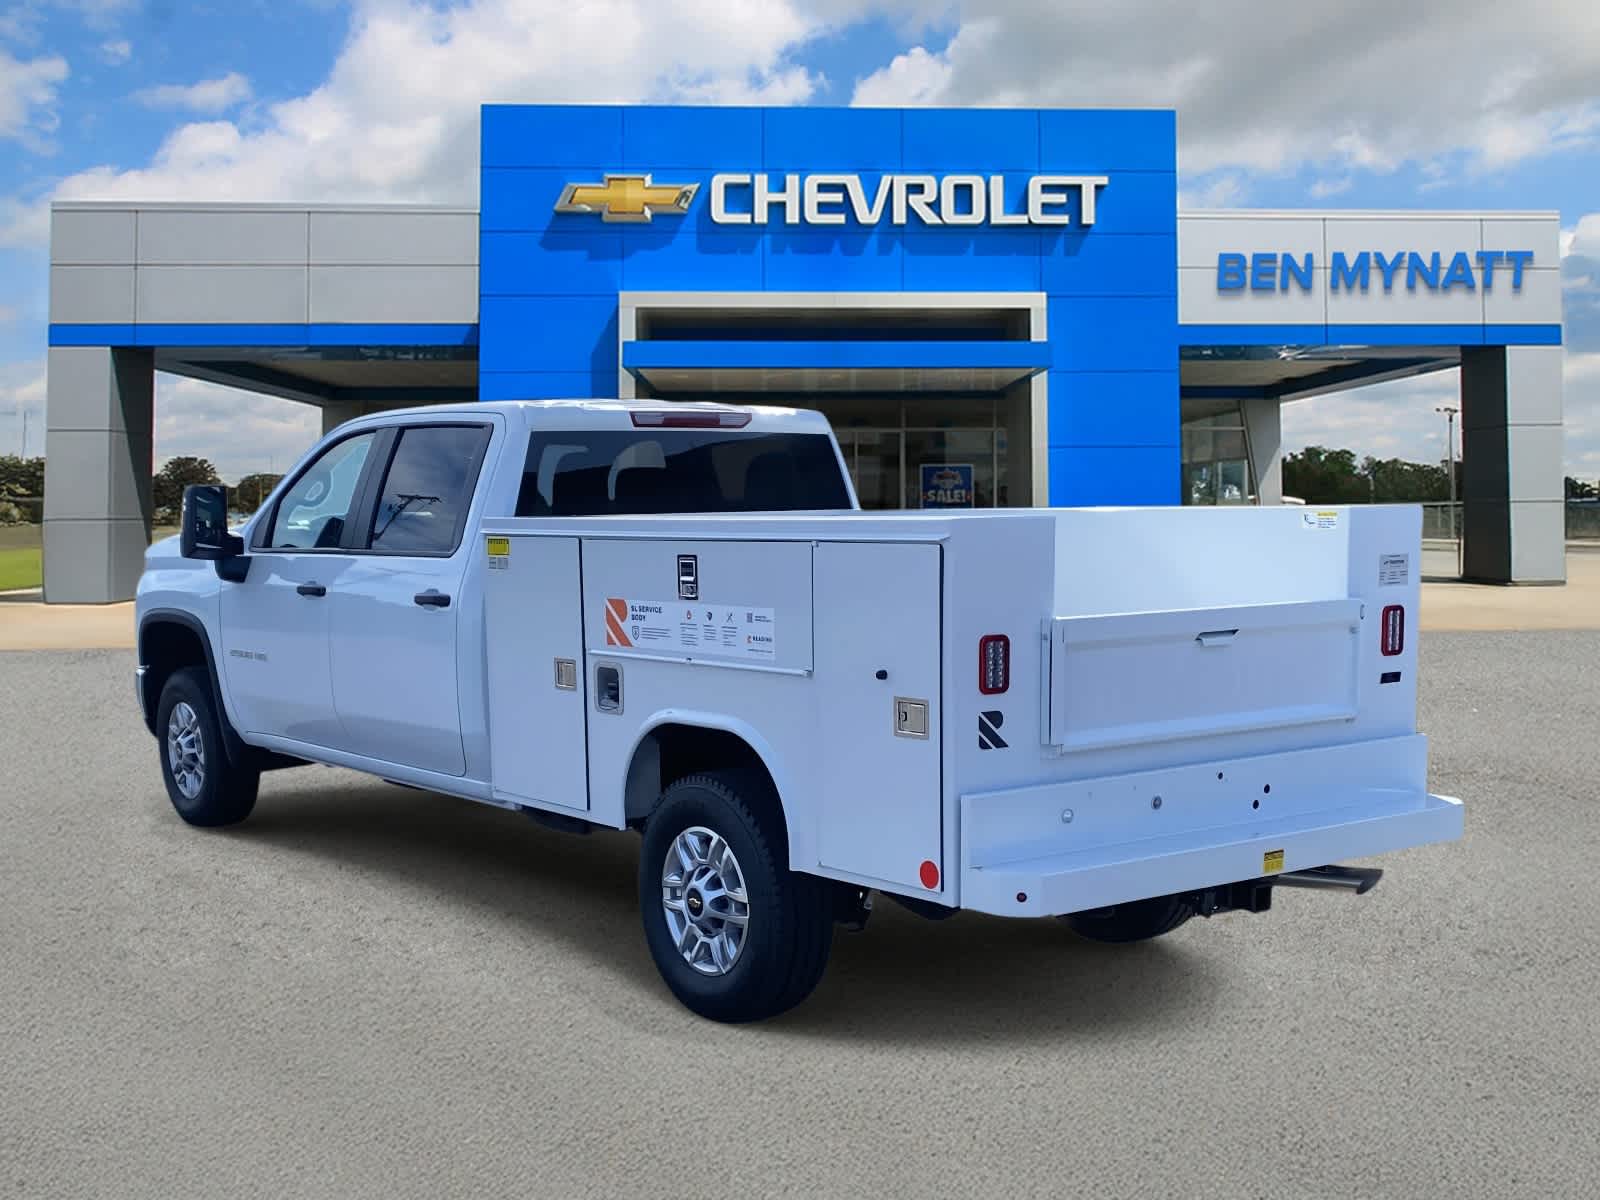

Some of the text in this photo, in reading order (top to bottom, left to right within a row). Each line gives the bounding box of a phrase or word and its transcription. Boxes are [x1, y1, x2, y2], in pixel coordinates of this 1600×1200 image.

[710, 173, 1110, 225] CHEVROLET
[1217, 251, 1534, 291] BEN MYNATT
[631, 614, 646, 622] BODY
[639, 605, 663, 614] SERVICE
